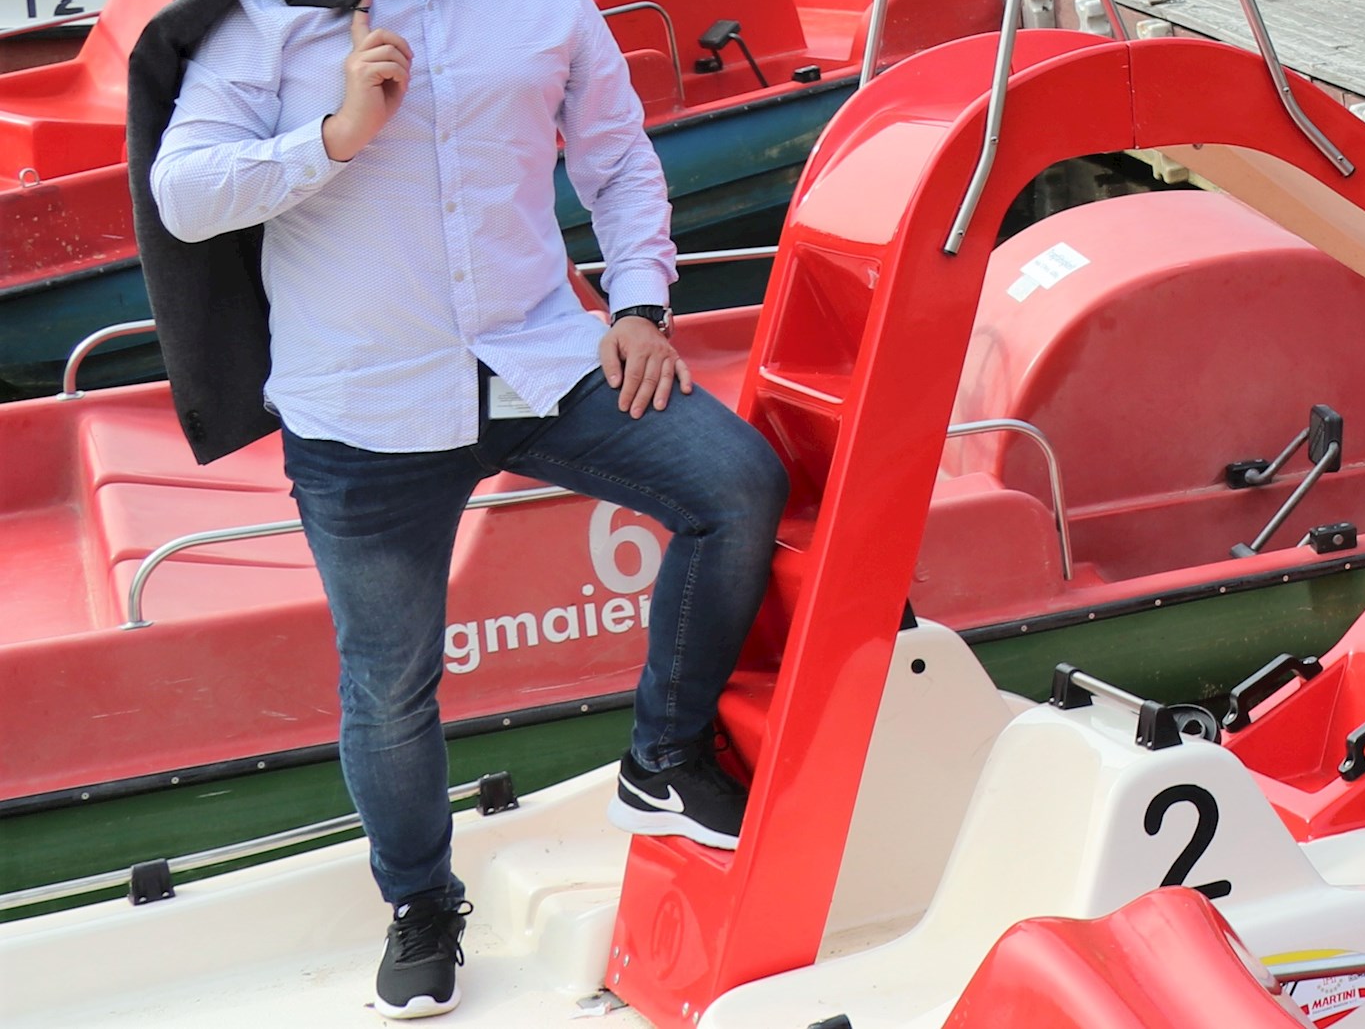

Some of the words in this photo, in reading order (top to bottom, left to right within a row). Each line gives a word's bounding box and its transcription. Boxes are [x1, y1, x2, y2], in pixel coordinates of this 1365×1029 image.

[589, 500, 662, 594] 6
[1143, 783, 1232, 900] 2
[1311, 988, 1356, 1010] MARTINI
